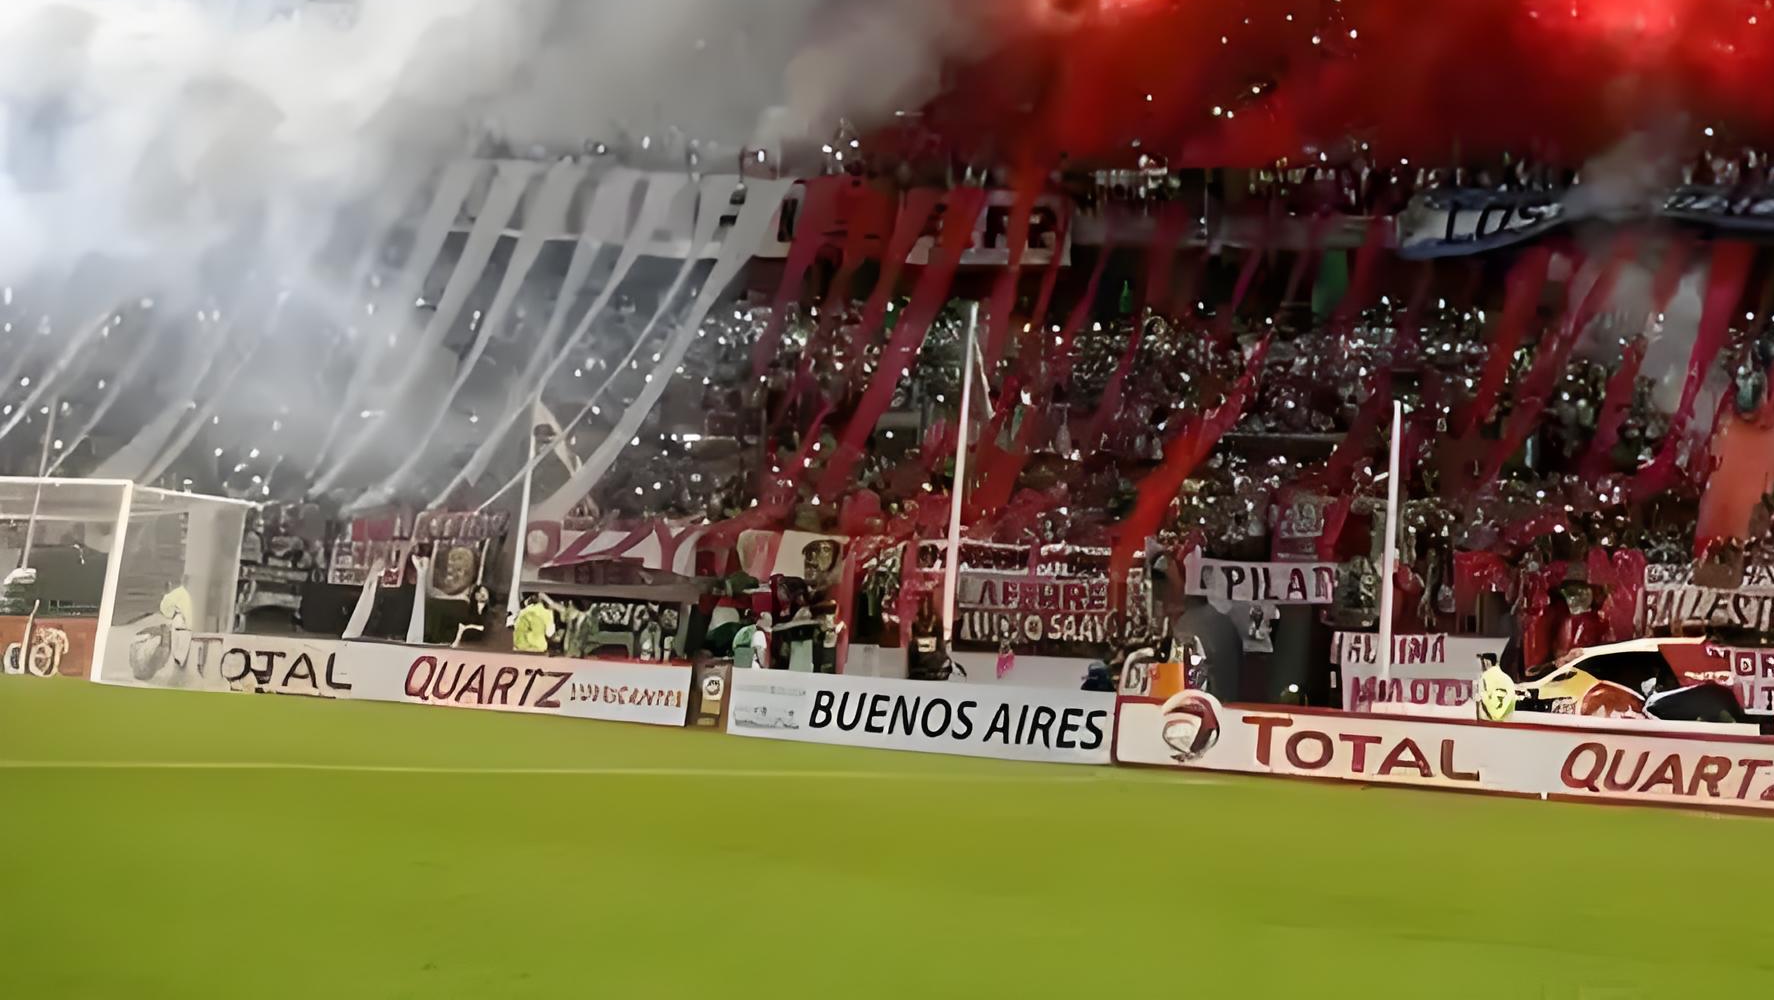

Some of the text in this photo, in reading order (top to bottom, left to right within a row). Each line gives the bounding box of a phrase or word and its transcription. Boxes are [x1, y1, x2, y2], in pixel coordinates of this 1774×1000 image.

[404, 655, 574, 708] QUARTZ
[809, 689, 1106, 750] BUENOS AIRES
[1242, 715, 1480, 783] TOTAL
